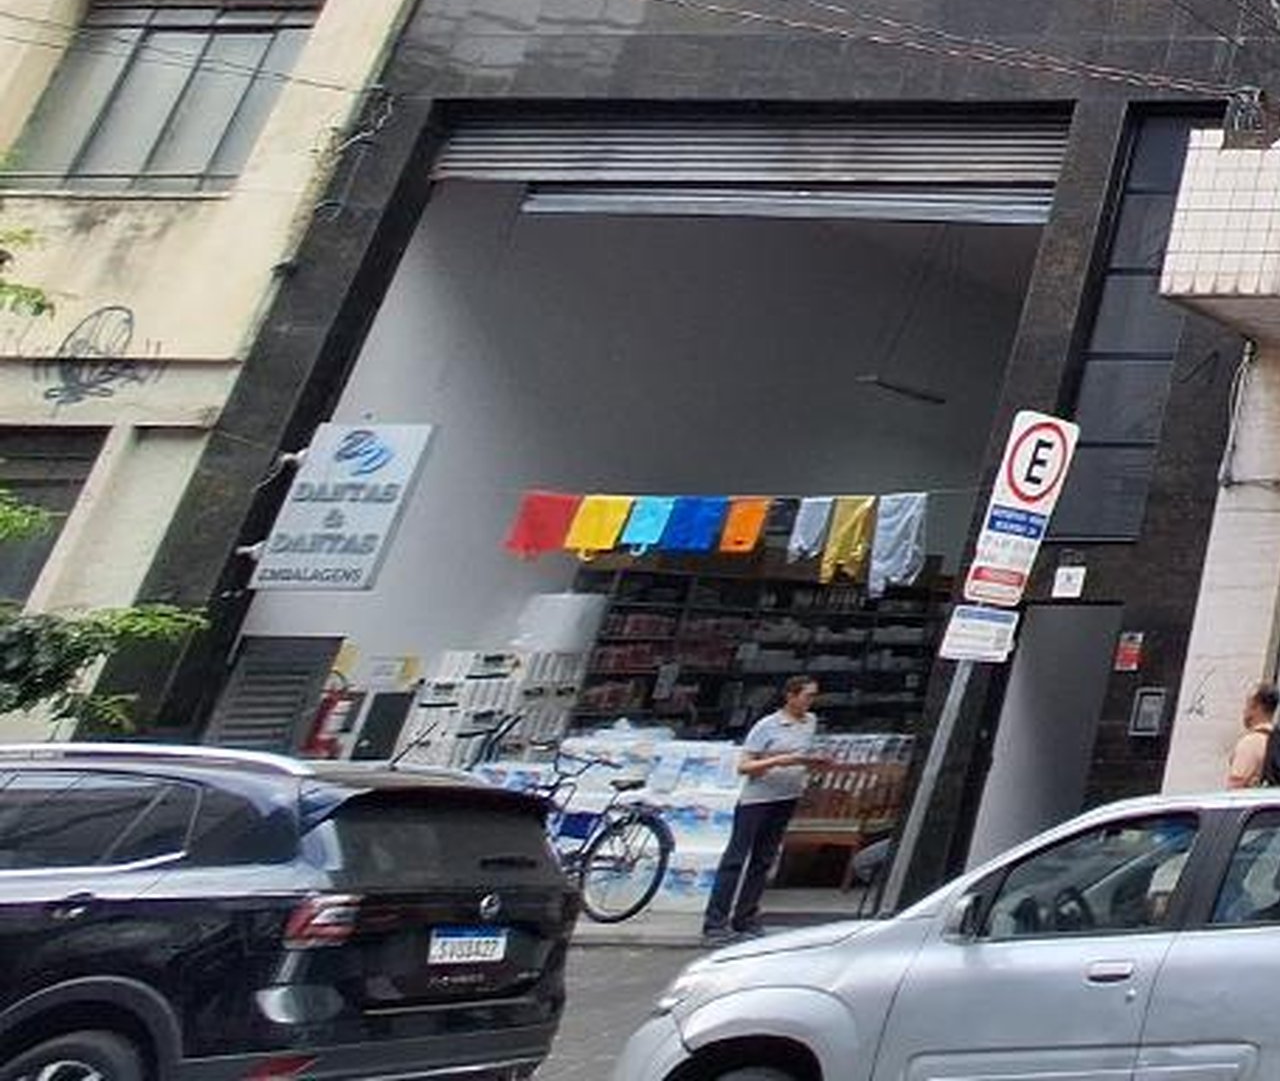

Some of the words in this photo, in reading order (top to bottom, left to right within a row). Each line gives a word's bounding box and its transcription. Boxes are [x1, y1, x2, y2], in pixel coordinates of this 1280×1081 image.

[1024, 438, 1054, 485] E
[292, 482, 401, 503] DANTAS
[267, 532, 380, 555] DANTAS
[256, 567, 364, 583] EMBALAGENS
